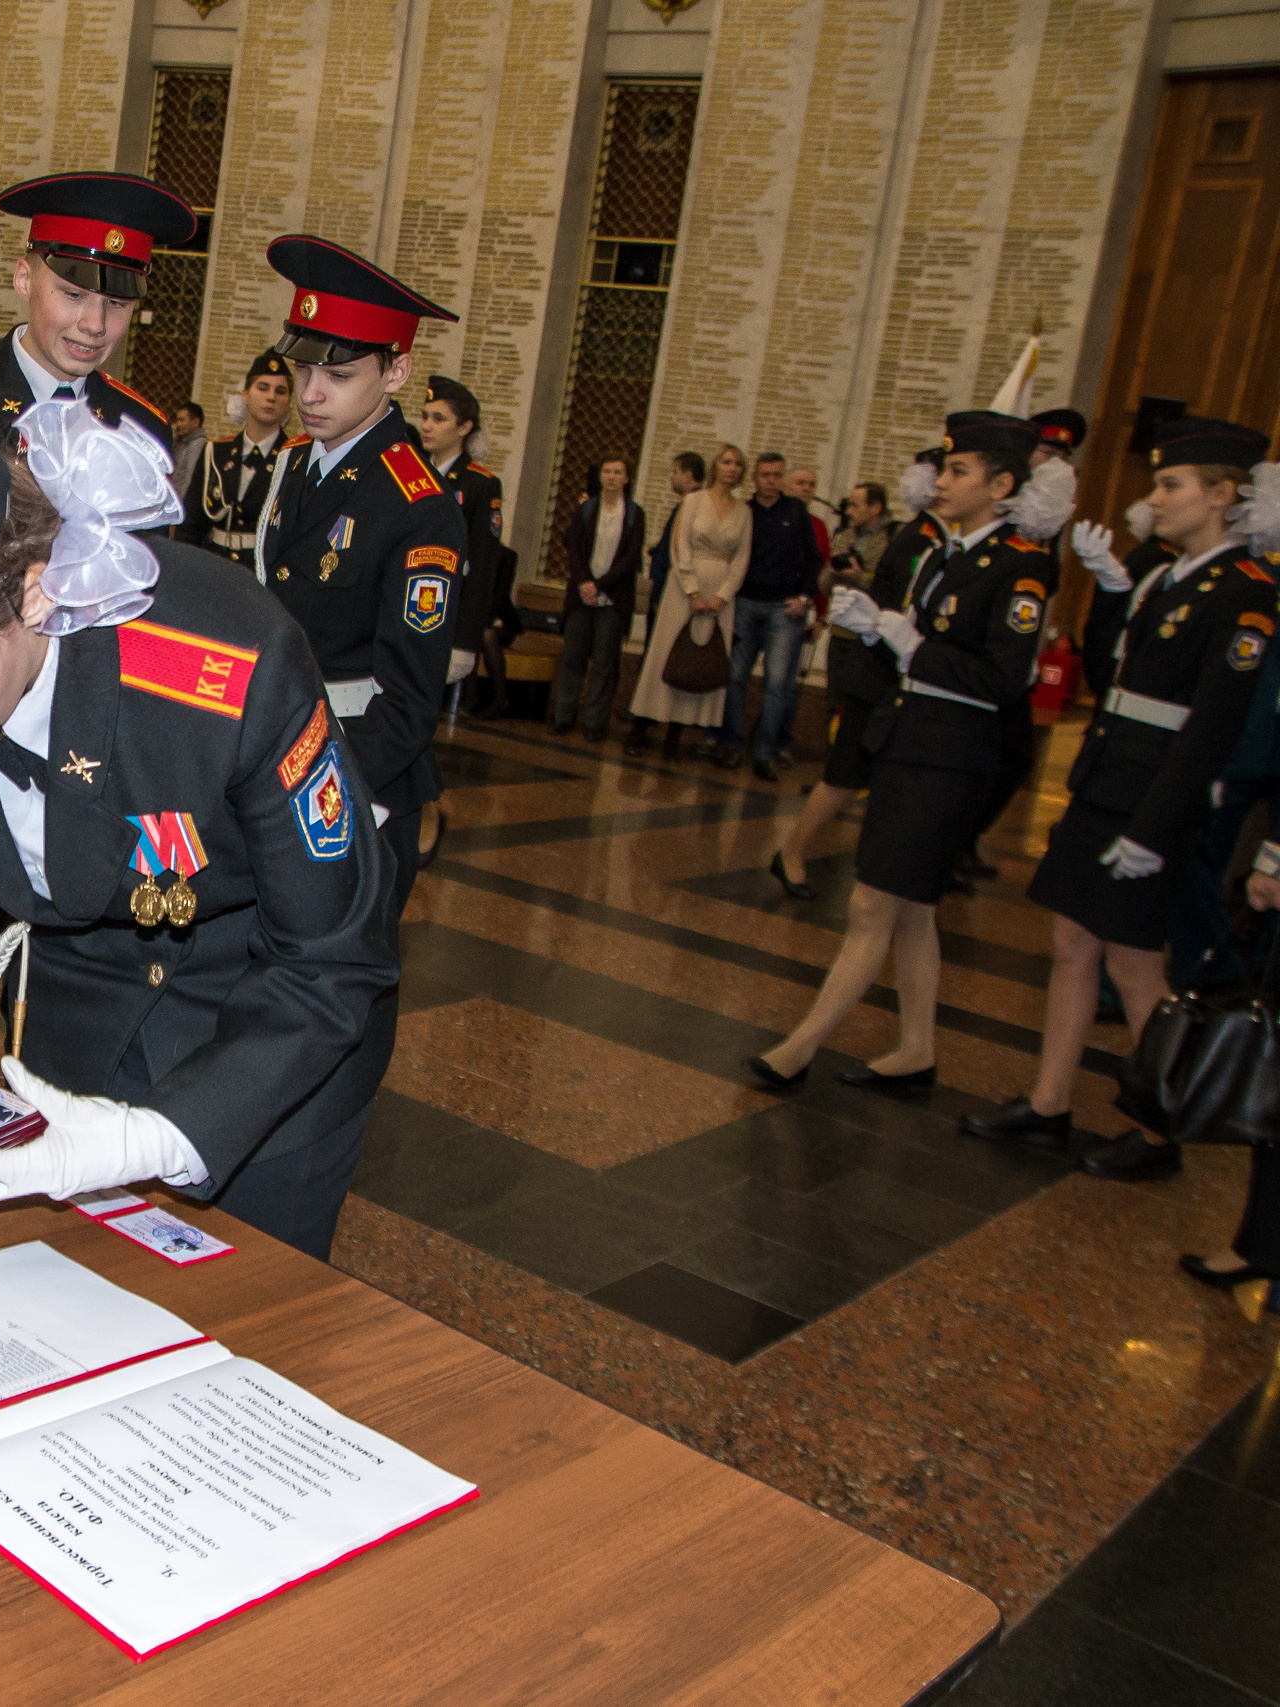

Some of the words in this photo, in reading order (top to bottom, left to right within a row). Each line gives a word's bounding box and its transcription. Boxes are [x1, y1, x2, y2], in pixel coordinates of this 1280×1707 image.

[407, 478, 431, 494] КК
[196, 654, 234, 700] КК
[237, 1376, 285, 1407] Клянусь!
[283, 1405, 334, 1437] Клянусь!
[40, 1434, 70, 1455] кадета
[332, 1435, 385, 1466] Клянусь!
[140, 1460, 192, 1496] Клянусь!
[36, 1500, 84, 1537] кадета
[58, 1487, 104, 1525] Ф.И.О.
[11, 1504, 115, 1589] Торжественная
